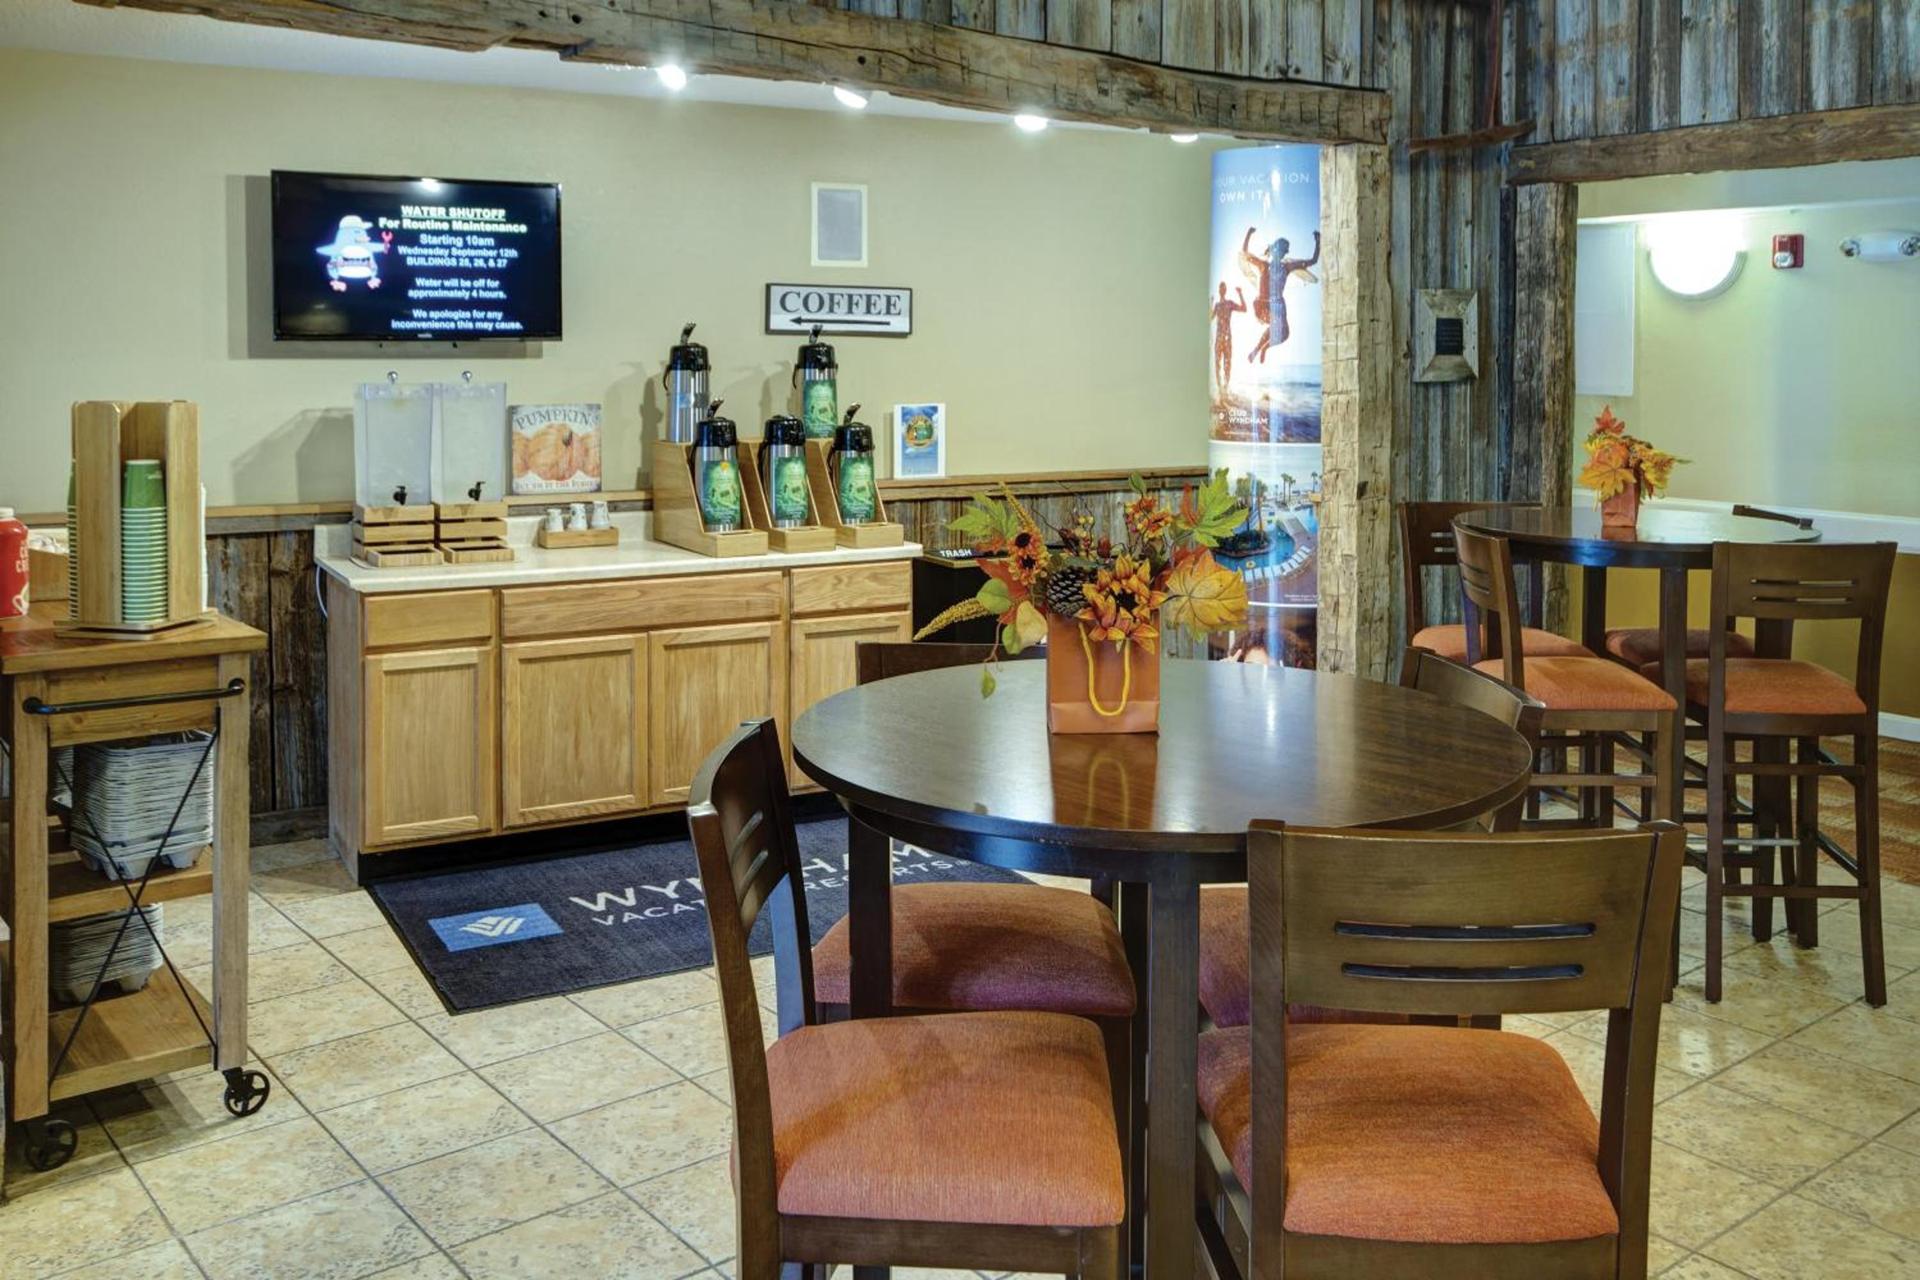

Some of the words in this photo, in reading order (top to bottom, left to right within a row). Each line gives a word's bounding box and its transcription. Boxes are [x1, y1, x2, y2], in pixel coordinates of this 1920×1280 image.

[1239, 172, 1311, 185] VACION
[1220, 191, 1245, 203] OWN
[401, 205, 444, 217] WATER
[449, 207, 506, 219] SHUTOFF
[378, 217, 400, 228] For
[403, 219, 449, 230] Routine
[452, 220, 528, 233] Maintenance
[420, 234, 463, 247] Starting
[466, 235, 495, 246] 10am
[398, 245, 449, 257] Wednesday
[451, 247, 497, 258] September
[406, 257, 457, 267] BUILDINGS
[415, 278, 441, 287] Water
[443, 278, 458, 287] will
[460, 278, 471, 288] be
[473, 278, 485, 288] off
[487, 279, 499, 288] for
[408, 289, 470, 300] approximately
[471, 290, 477, 298] 4
[779, 291, 902, 316] COFFEE
[412, 310, 427, 319] We
[429, 310, 471, 320] apologize
[473, 310, 485, 319] for
[487, 311, 503, 320] any
[457, 320, 473, 329] this
[475, 322, 493, 331] may
[940, 548, 973, 558] TRASH
